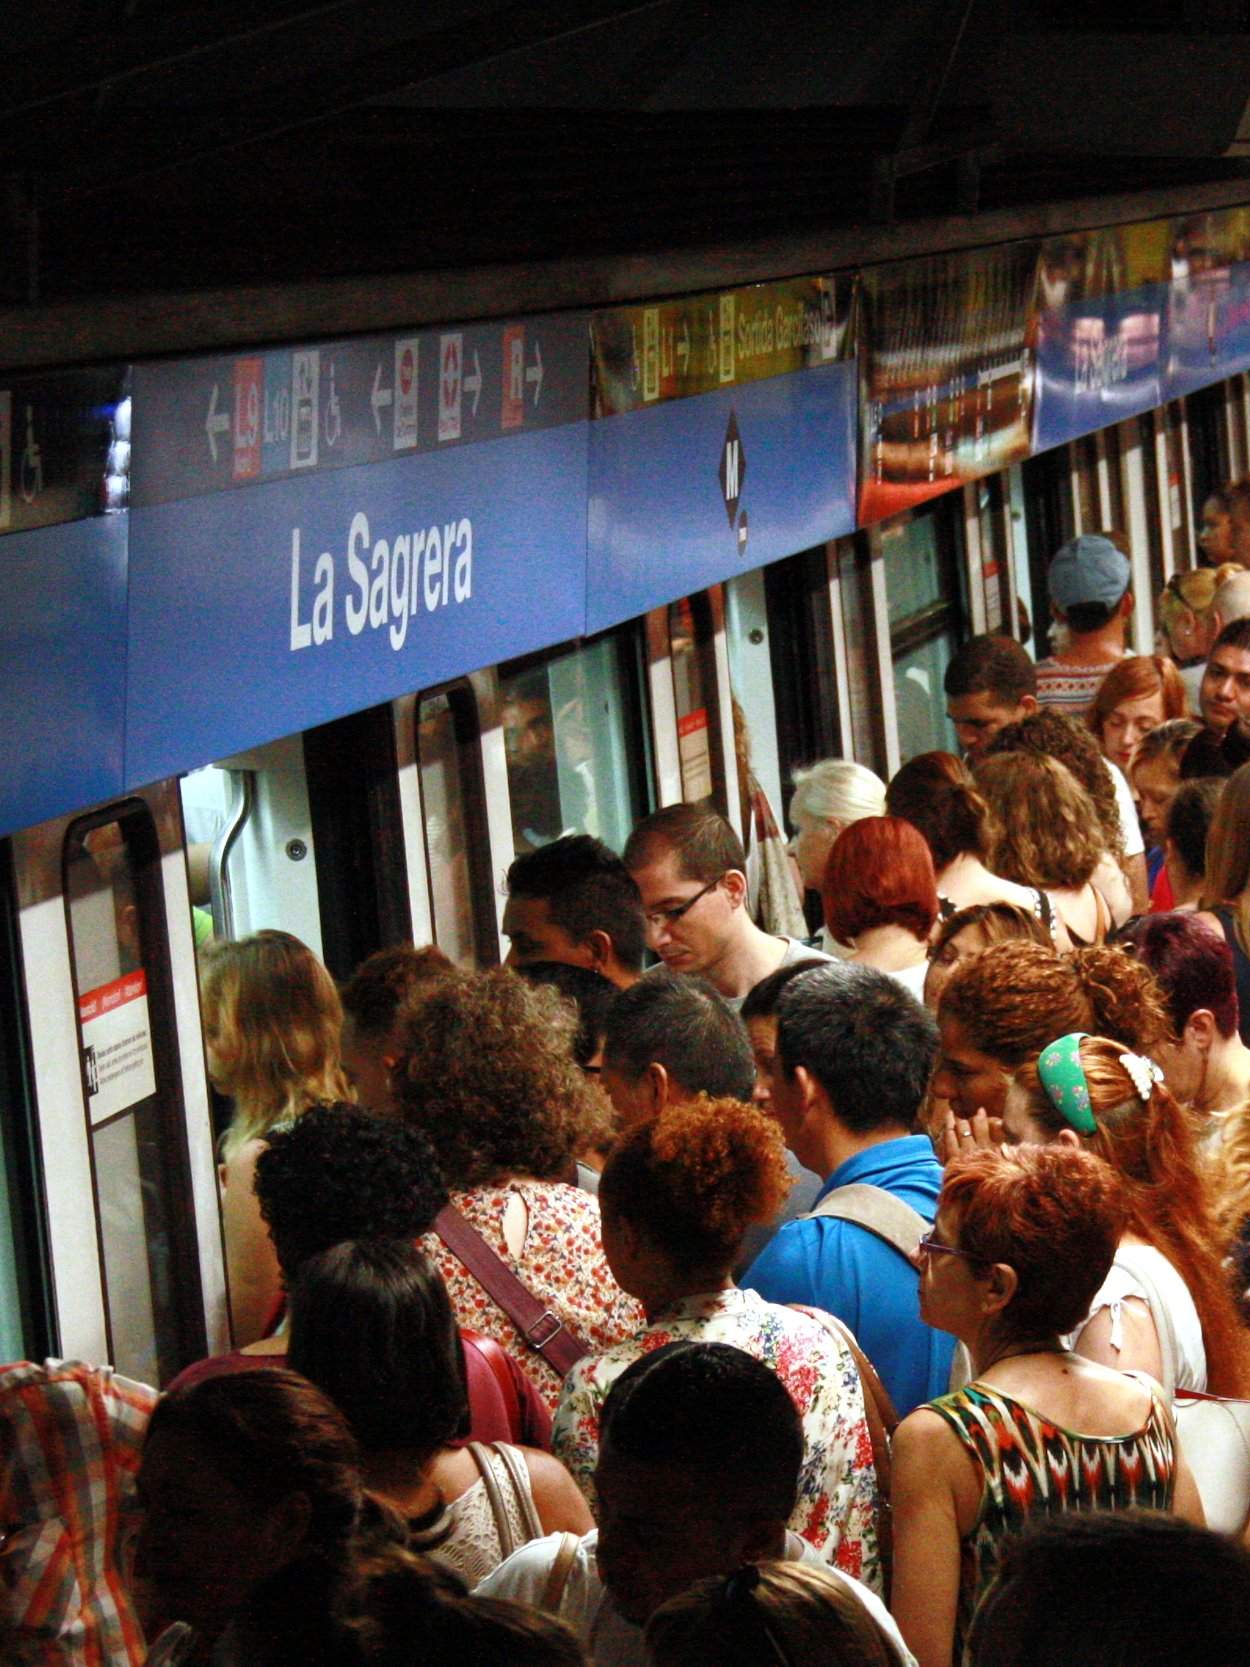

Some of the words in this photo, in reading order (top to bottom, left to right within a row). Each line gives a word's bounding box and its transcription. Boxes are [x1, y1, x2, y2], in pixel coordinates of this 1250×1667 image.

[233, 381, 258, 449] L9
[263, 386, 290, 444] L10
[725, 439, 739, 501] M
[290, 527, 335, 651] La
[345, 511, 473, 651] Sagrera
